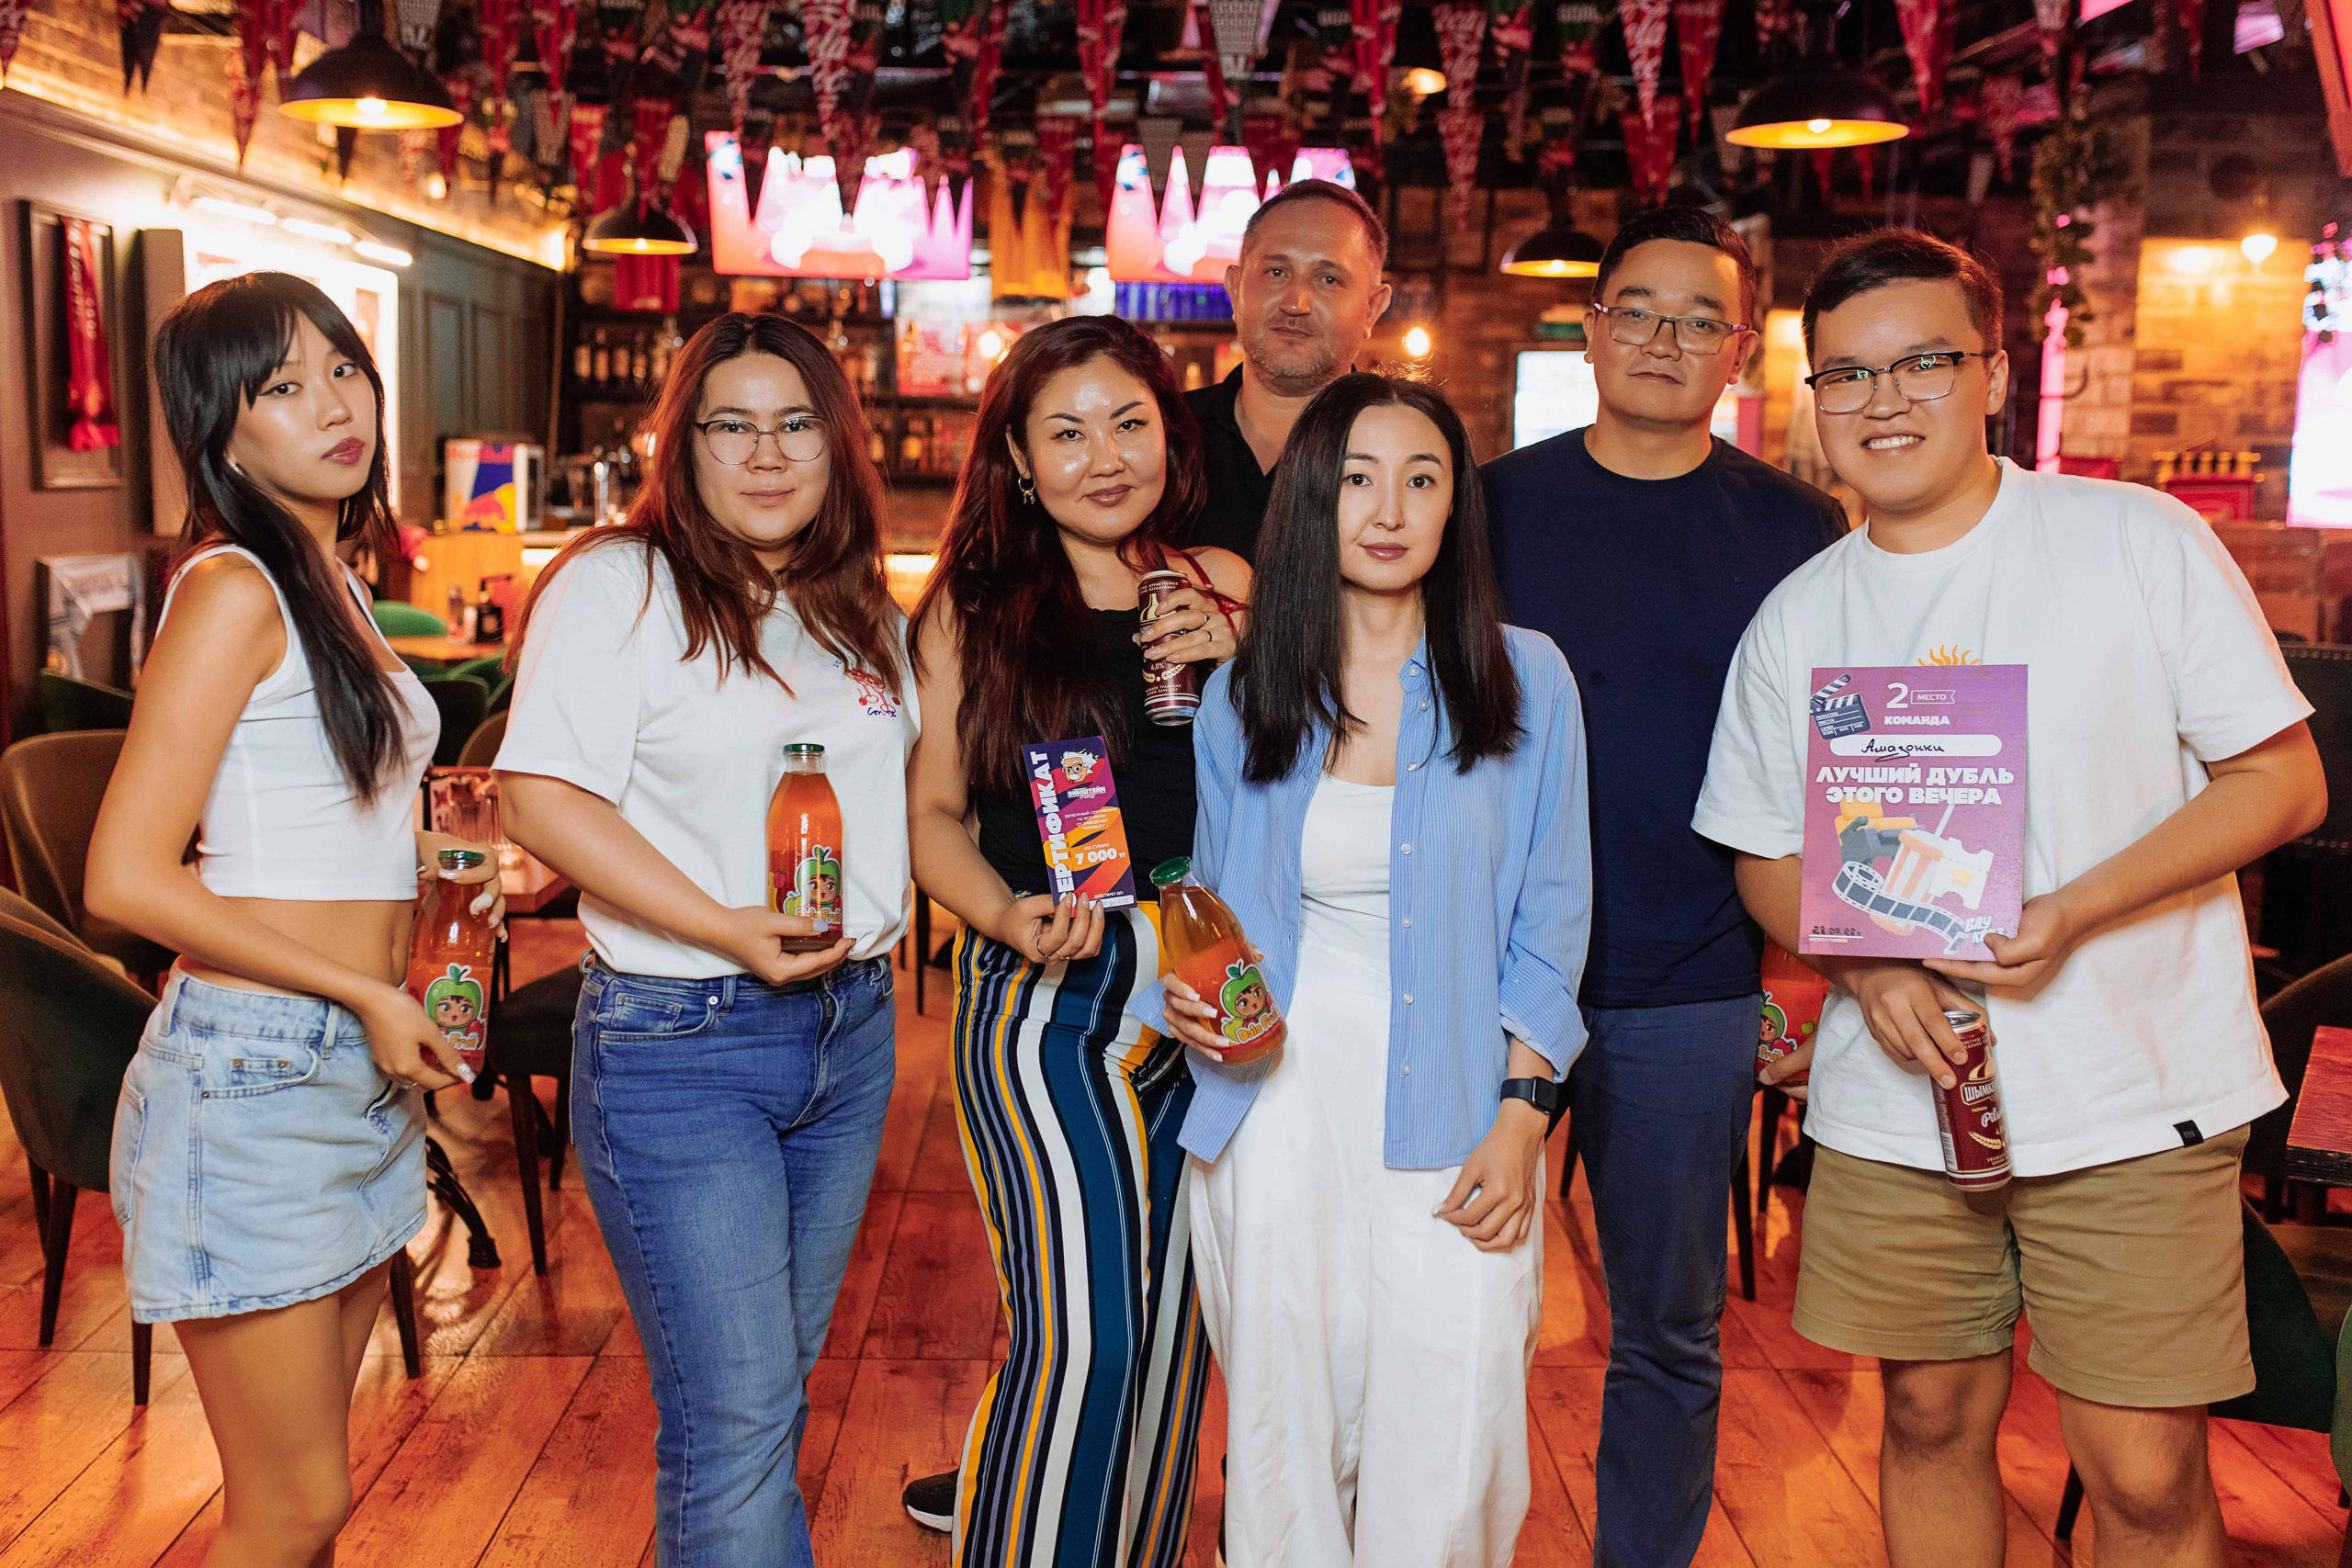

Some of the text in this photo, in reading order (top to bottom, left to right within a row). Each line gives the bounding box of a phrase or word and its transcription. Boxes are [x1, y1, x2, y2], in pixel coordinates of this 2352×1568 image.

[1886, 682, 1947, 709] 2 МЕСТО
[1883, 716, 1951, 726] КОМАНДА
[1861, 738, 1945, 763] Амазонки
[1815, 763, 2015, 785] ЛУЧШИЙ ДУБЛЬ
[1826, 786, 2003, 805] ЭТОГО ВЕЧЕРА
[1075, 852, 1084, 865] 7
[1087, 848, 1118, 863] 000
[1963, 1082, 1997, 1102] ШЫМКЕ
